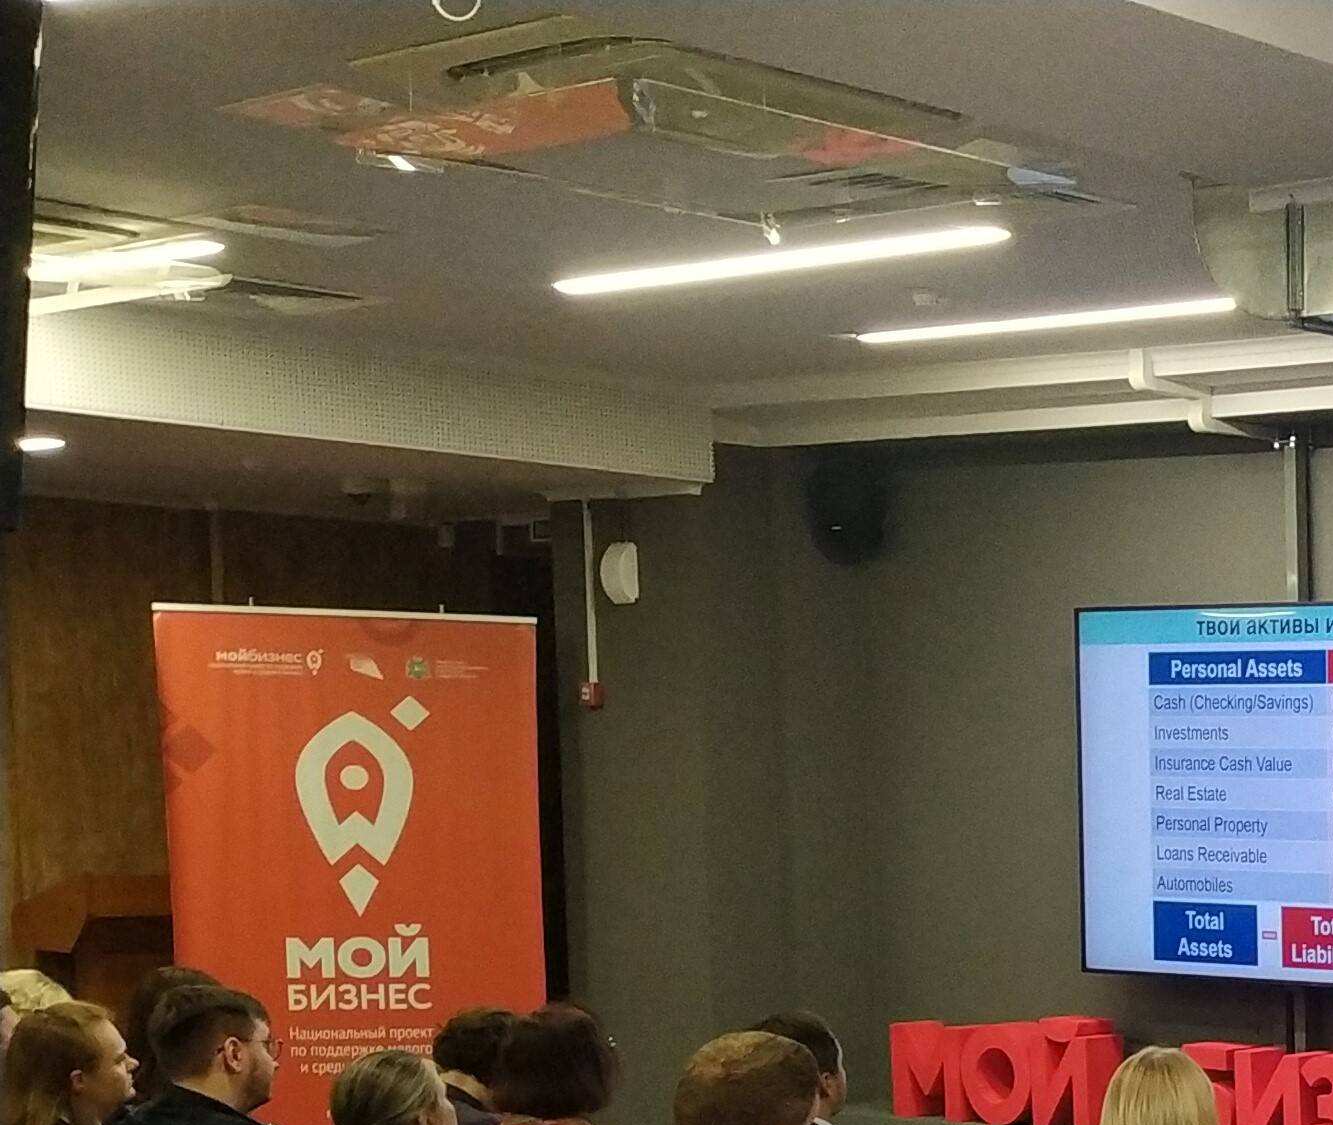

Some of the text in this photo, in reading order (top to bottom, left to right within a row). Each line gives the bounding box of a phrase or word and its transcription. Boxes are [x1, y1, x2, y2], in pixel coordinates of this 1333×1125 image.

[1196, 619, 1241, 637] твои
[1246, 618, 1319, 636] активы
[1170, 658, 1303, 679] Personal Assets
[1153, 693, 1314, 714] Cash (Checking/Savings)
[1154, 725, 1229, 741] Investments
[1154, 755, 1293, 773] Insurance Cash Value
[1155, 784, 1227, 802] Real Estate
[1155, 814, 1269, 838] Personal Property
[1156, 844, 1268, 864] Loans Receivable
[1156, 875, 1234, 894] Automobiles
[1184, 910, 1225, 931] Total
[285, 923, 430, 979] МОЙ
[1177, 937, 1233, 958] Assets
[287, 983, 432, 1010] БИЗНЕС
[289, 1026, 435, 1041] Национальный проект
[291, 1046, 307, 1057] по
[300, 1064, 308, 1072] и
